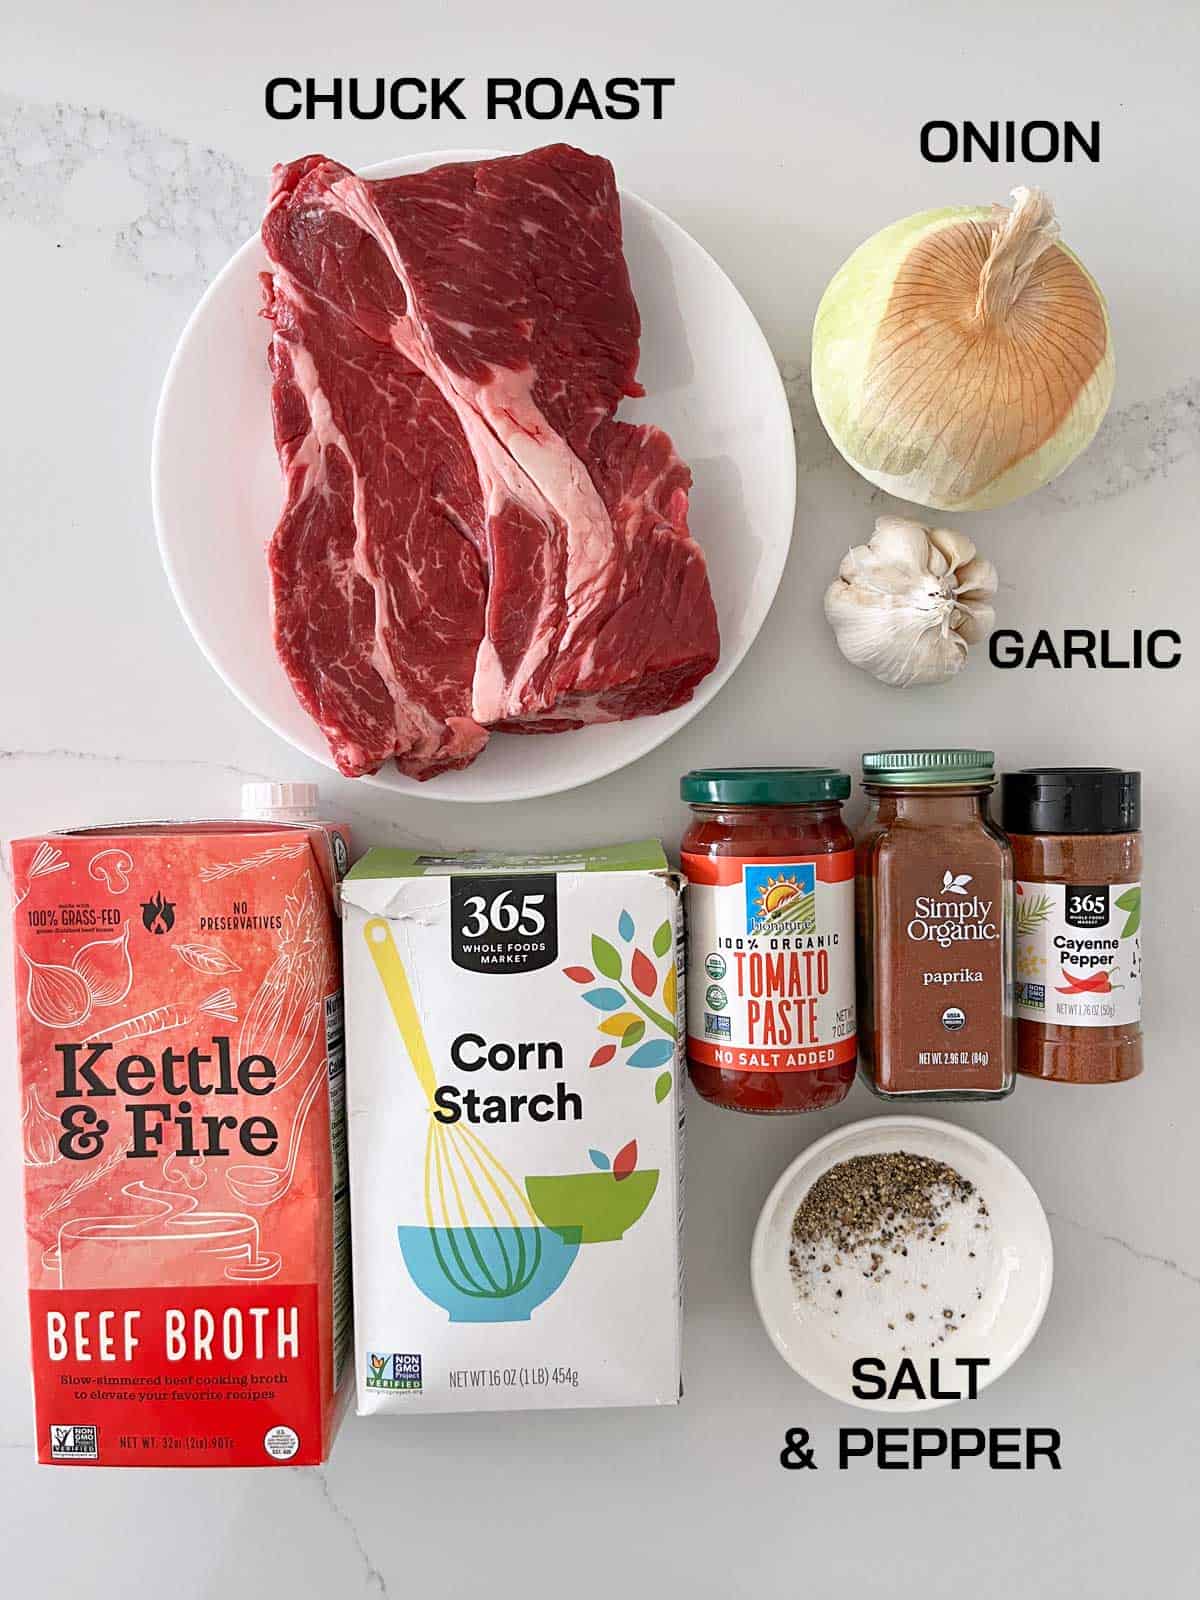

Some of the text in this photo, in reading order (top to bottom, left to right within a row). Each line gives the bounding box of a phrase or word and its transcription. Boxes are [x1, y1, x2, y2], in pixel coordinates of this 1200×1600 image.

[233, 902, 248, 914] NO
[462, 889, 545, 937] 365
[915, 896, 993, 925] Simply
[1069, 895, 1105, 914] 365
[28, 908, 121, 927] 100% GRASS-FED
[200, 916, 282, 930] PRESERVATIVES
[462, 942, 546, 953] WHOLE FOODS
[718, 934, 839, 950] 100% ORGANIC
[1053, 935, 1119, 953] Cayenne
[480, 954, 528, 964] MARKET
[1060, 951, 1115, 969] Pepper
[733, 949, 829, 998] TOMATO
[923, 968, 984, 986] paprika
[747, 998, 819, 1046] PASTE
[451, 1033, 563, 1072] Corn
[714, 1048, 836, 1068] NO SALT ADDED
[919, 1052, 930, 1065] NET
[55, 1037, 277, 1098] Kettle
[433, 1082, 582, 1124] Starch
[59, 1101, 278, 1161] & Fire
[47, 1306, 299, 1362] BEEF BROTH
[394, 1355, 420, 1364] NON
[394, 1364, 420, 1372] GMO
[251, 1372, 288, 1385] broth
[369, 1378, 421, 1388] VERIFIED
[450, 1366, 579, 1388] NET WT 16 OZ (1 LB) 454g
[74, 1390, 88, 1400] to
[90, 1390, 137, 1400] elevate
[138, 1391, 168, 1402] your
[120, 1436, 138, 1449] NET
